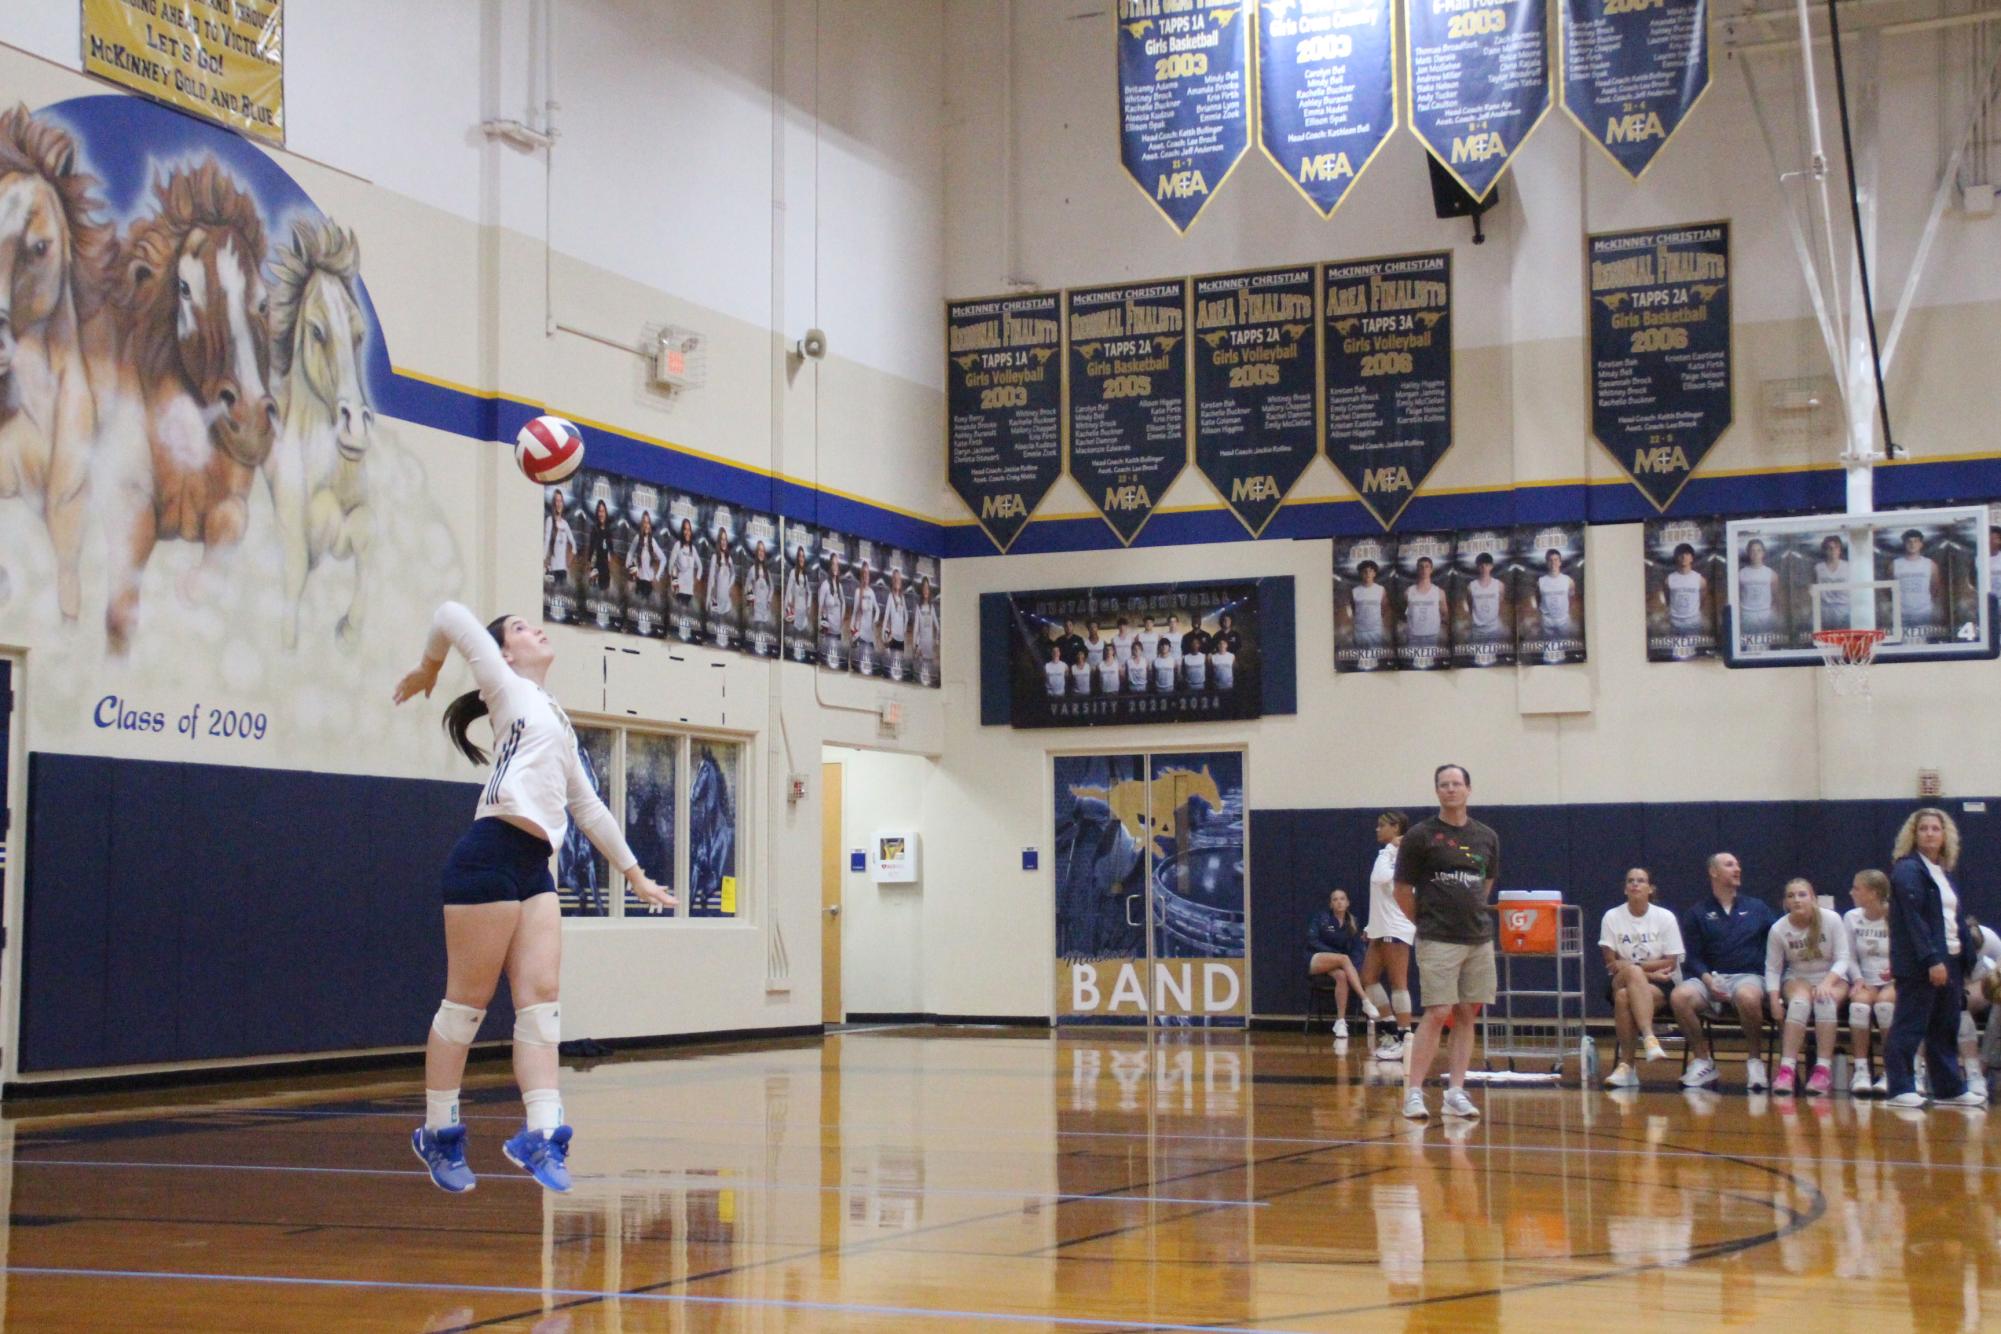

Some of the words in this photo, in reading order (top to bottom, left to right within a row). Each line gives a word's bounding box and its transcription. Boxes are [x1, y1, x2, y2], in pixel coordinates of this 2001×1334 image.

[1159, 16, 1191, 35] TAPPS
[1192, 14, 1205, 31] 1A
[1447, 9, 1506, 39] 2003
[1145, 39, 1168, 55] Girls
[1169, 29, 1219, 52] Basketball
[1155, 53, 1208, 81] 2003
[1656, 229, 1721, 243] CHRISTIAN
[1385, 258, 1444, 272] CHRISTIAN
[1252, 271, 1309, 286] CHRISTIAN
[1125, 285, 1180, 298] CHRISTIAN
[1631, 289, 1670, 308] TAPPS
[1672, 288, 1688, 304] 2A
[1002, 298, 1055, 311] CHRISTIAN
[1362, 316, 1396, 333] TAPPS
[1399, 315, 1413, 330] 3A
[1612, 313, 1640, 329] Girls
[1643, 304, 1707, 326] Basketball
[1230, 329, 1263, 346] TAPPS
[1266, 328, 1280, 341] 2A
[1343, 338, 1370, 354] Girls
[1374, 330, 1431, 352] Volleyball
[1630, 327, 1688, 353] 2006
[1104, 341, 1136, 357] TAPPS
[1138, 340, 1152, 354] 2A
[1213, 349, 1239, 365] Girls
[1242, 343, 1297, 363] Volleyball
[982, 352, 1013, 368] TAPPS
[1015, 351, 1028, 365] 1A
[1087, 361, 1111, 377] Girls
[1114, 355, 1169, 374] Basketball
[1360, 351, 1413, 377] 2006
[965, 373, 990, 387] Girls
[992, 366, 1044, 385] Volleyball
[1229, 363, 1280, 388] 2005
[981, 385, 1028, 409] 2003
[1103, 375, 1151, 399] 2005
[93, 695, 165, 733] Class
[178, 703, 200, 740] of
[208, 708, 268, 740] 2009
[1050, 701, 1119, 717] VARSITY
[1512, 911, 1525, 927] G
[1072, 963, 1240, 1012] BAND
